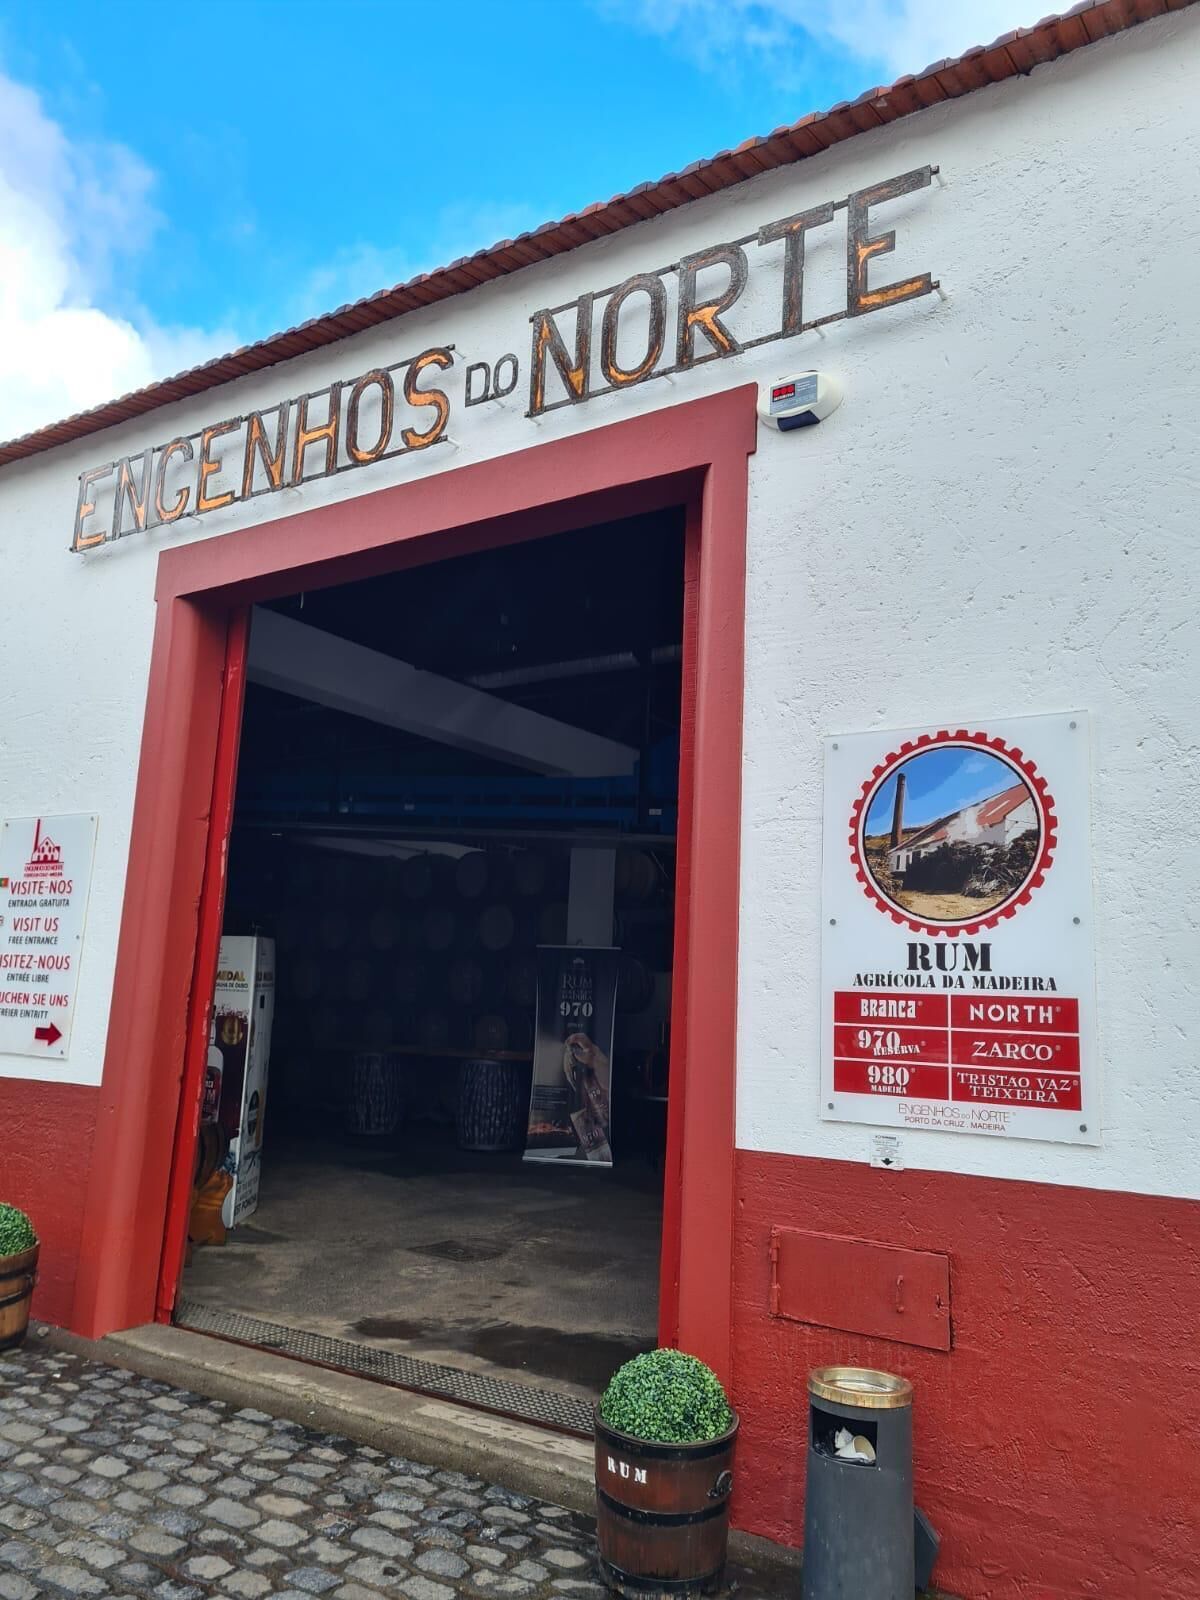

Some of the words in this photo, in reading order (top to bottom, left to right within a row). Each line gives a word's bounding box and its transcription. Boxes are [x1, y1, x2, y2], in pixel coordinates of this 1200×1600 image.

[73, 346, 453, 551] ENGENHOS
[465, 353, 518, 408] DO
[527, 165, 932, 418] NORTE
[10, 879, 73, 895] VISITE-NOS
[8, 898, 38, 908] ENTRADA
[39, 897, 70, 907] GRATUITA
[13, 917, 41, 932] VISIT
[44, 917, 59, 932] US
[8, 936, 23, 945] FREE
[24, 936, 58, 945] ENTRANCE
[906, 942, 993, 972] RUM
[6, 972, 30, 983] ENTRÉE
[31, 974, 49, 984] LIBRE
[852, 970, 937, 989] AGRÍCOLA
[942, 975, 966, 989] DA
[972, 975, 1058, 992] MADEIRA
[32, 993, 46, 1006] SIE
[49, 993, 69, 1008] UNS
[560, 1000, 594, 1017] 970
[20, 1009, 49, 1020] EINTRITT
[969, 1003, 1054, 1024] NORTH
[858, 1029, 901, 1053] 970
[873, 1044, 921, 1056] RESERVA
[972, 1041, 1053, 1061] ZARCO
[867, 1065, 910, 1087] 980
[871, 1084, 907, 1095] MADEIRA
[1037, 1078, 1073, 1091] VAZ
[969, 1085, 1059, 1103] TEIXEIRA
[904, 1115, 929, 1125] PORTO
[931, 1118, 942, 1126] DA
[943, 1120, 965, 1128] CRUZ
[970, 1122, 1006, 1132] MADEIRA
[971, 1108, 1010, 1123] NORTE
[607, 1456, 648, 1484] RUM
